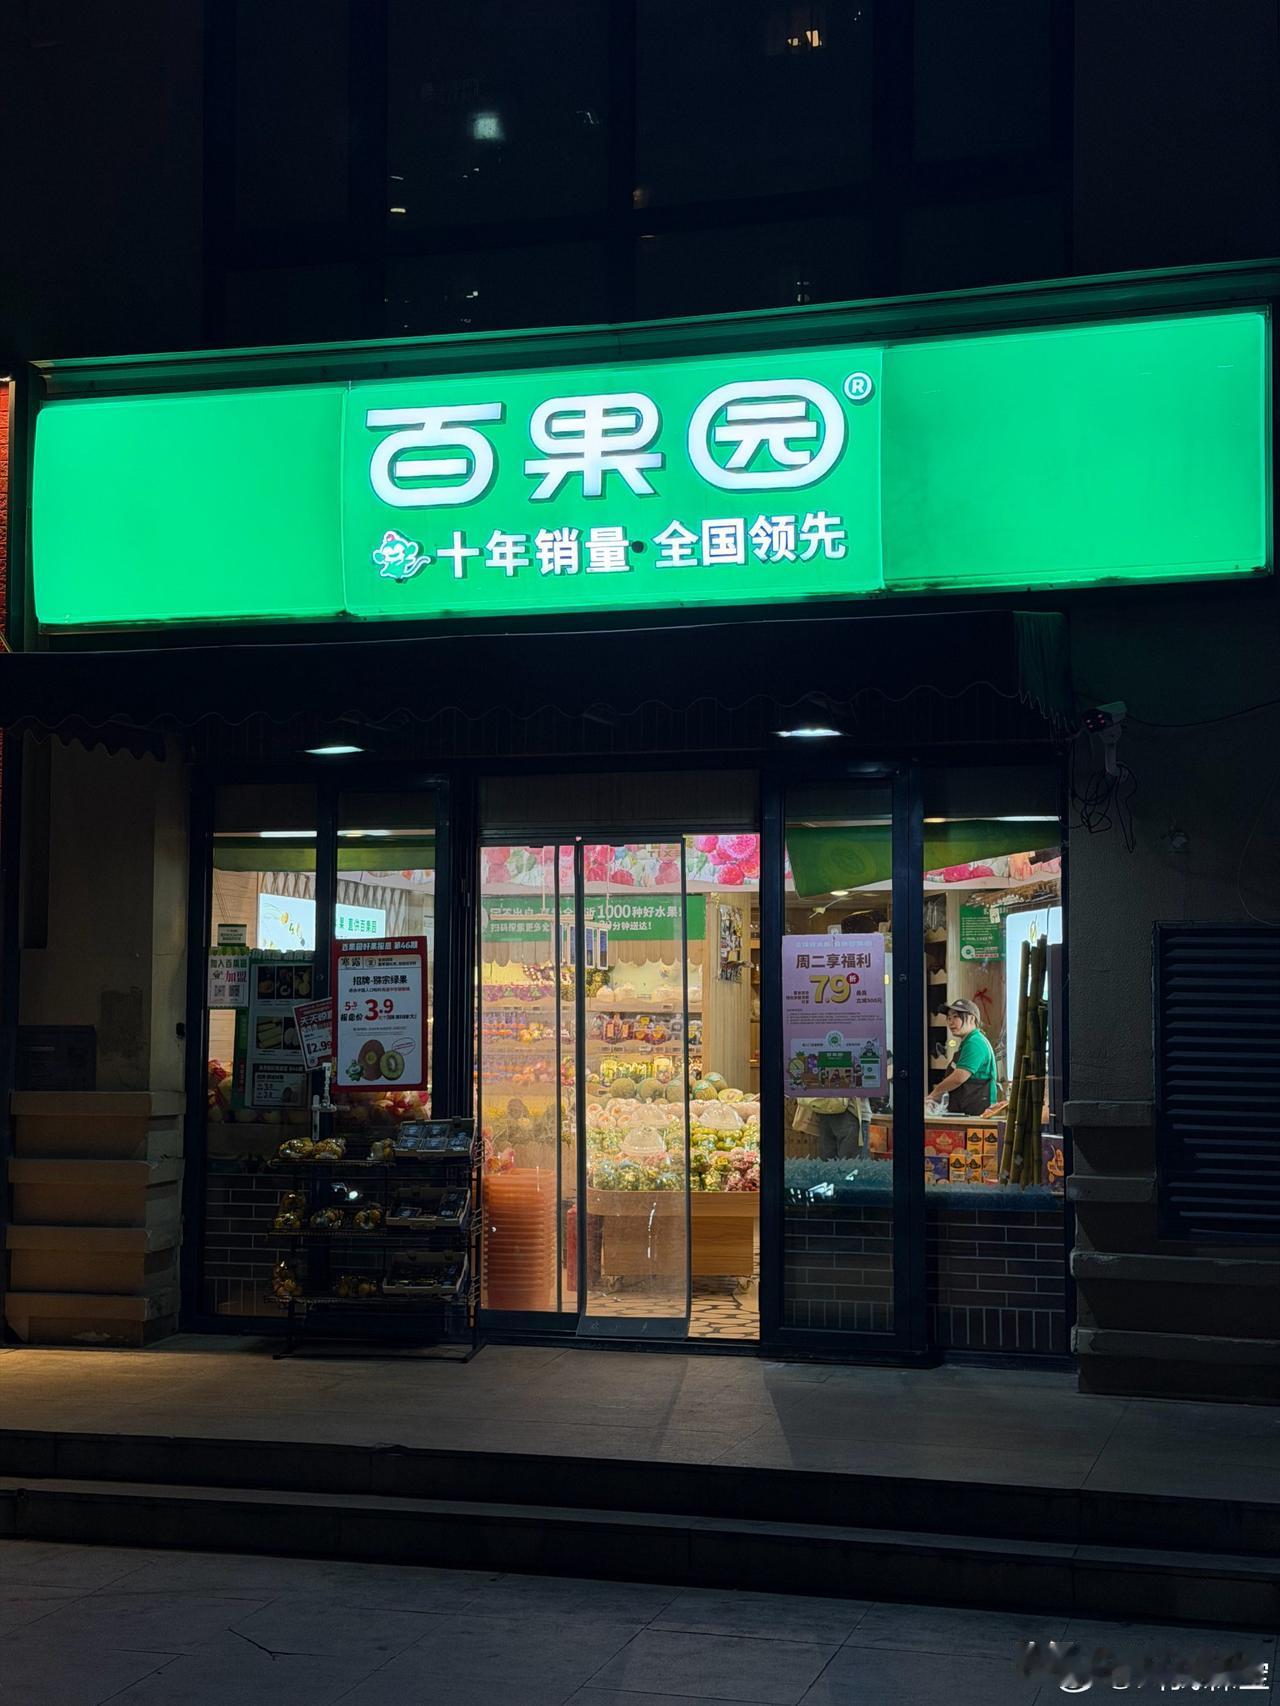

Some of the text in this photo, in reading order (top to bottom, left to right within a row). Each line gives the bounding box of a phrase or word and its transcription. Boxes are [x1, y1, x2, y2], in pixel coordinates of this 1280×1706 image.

[366, 379, 847, 508] 百果园
[796, 952, 871, 969] 周二享福利
[808, 974, 852, 1004] 7.9
[364, 998, 394, 1021] 3.9
